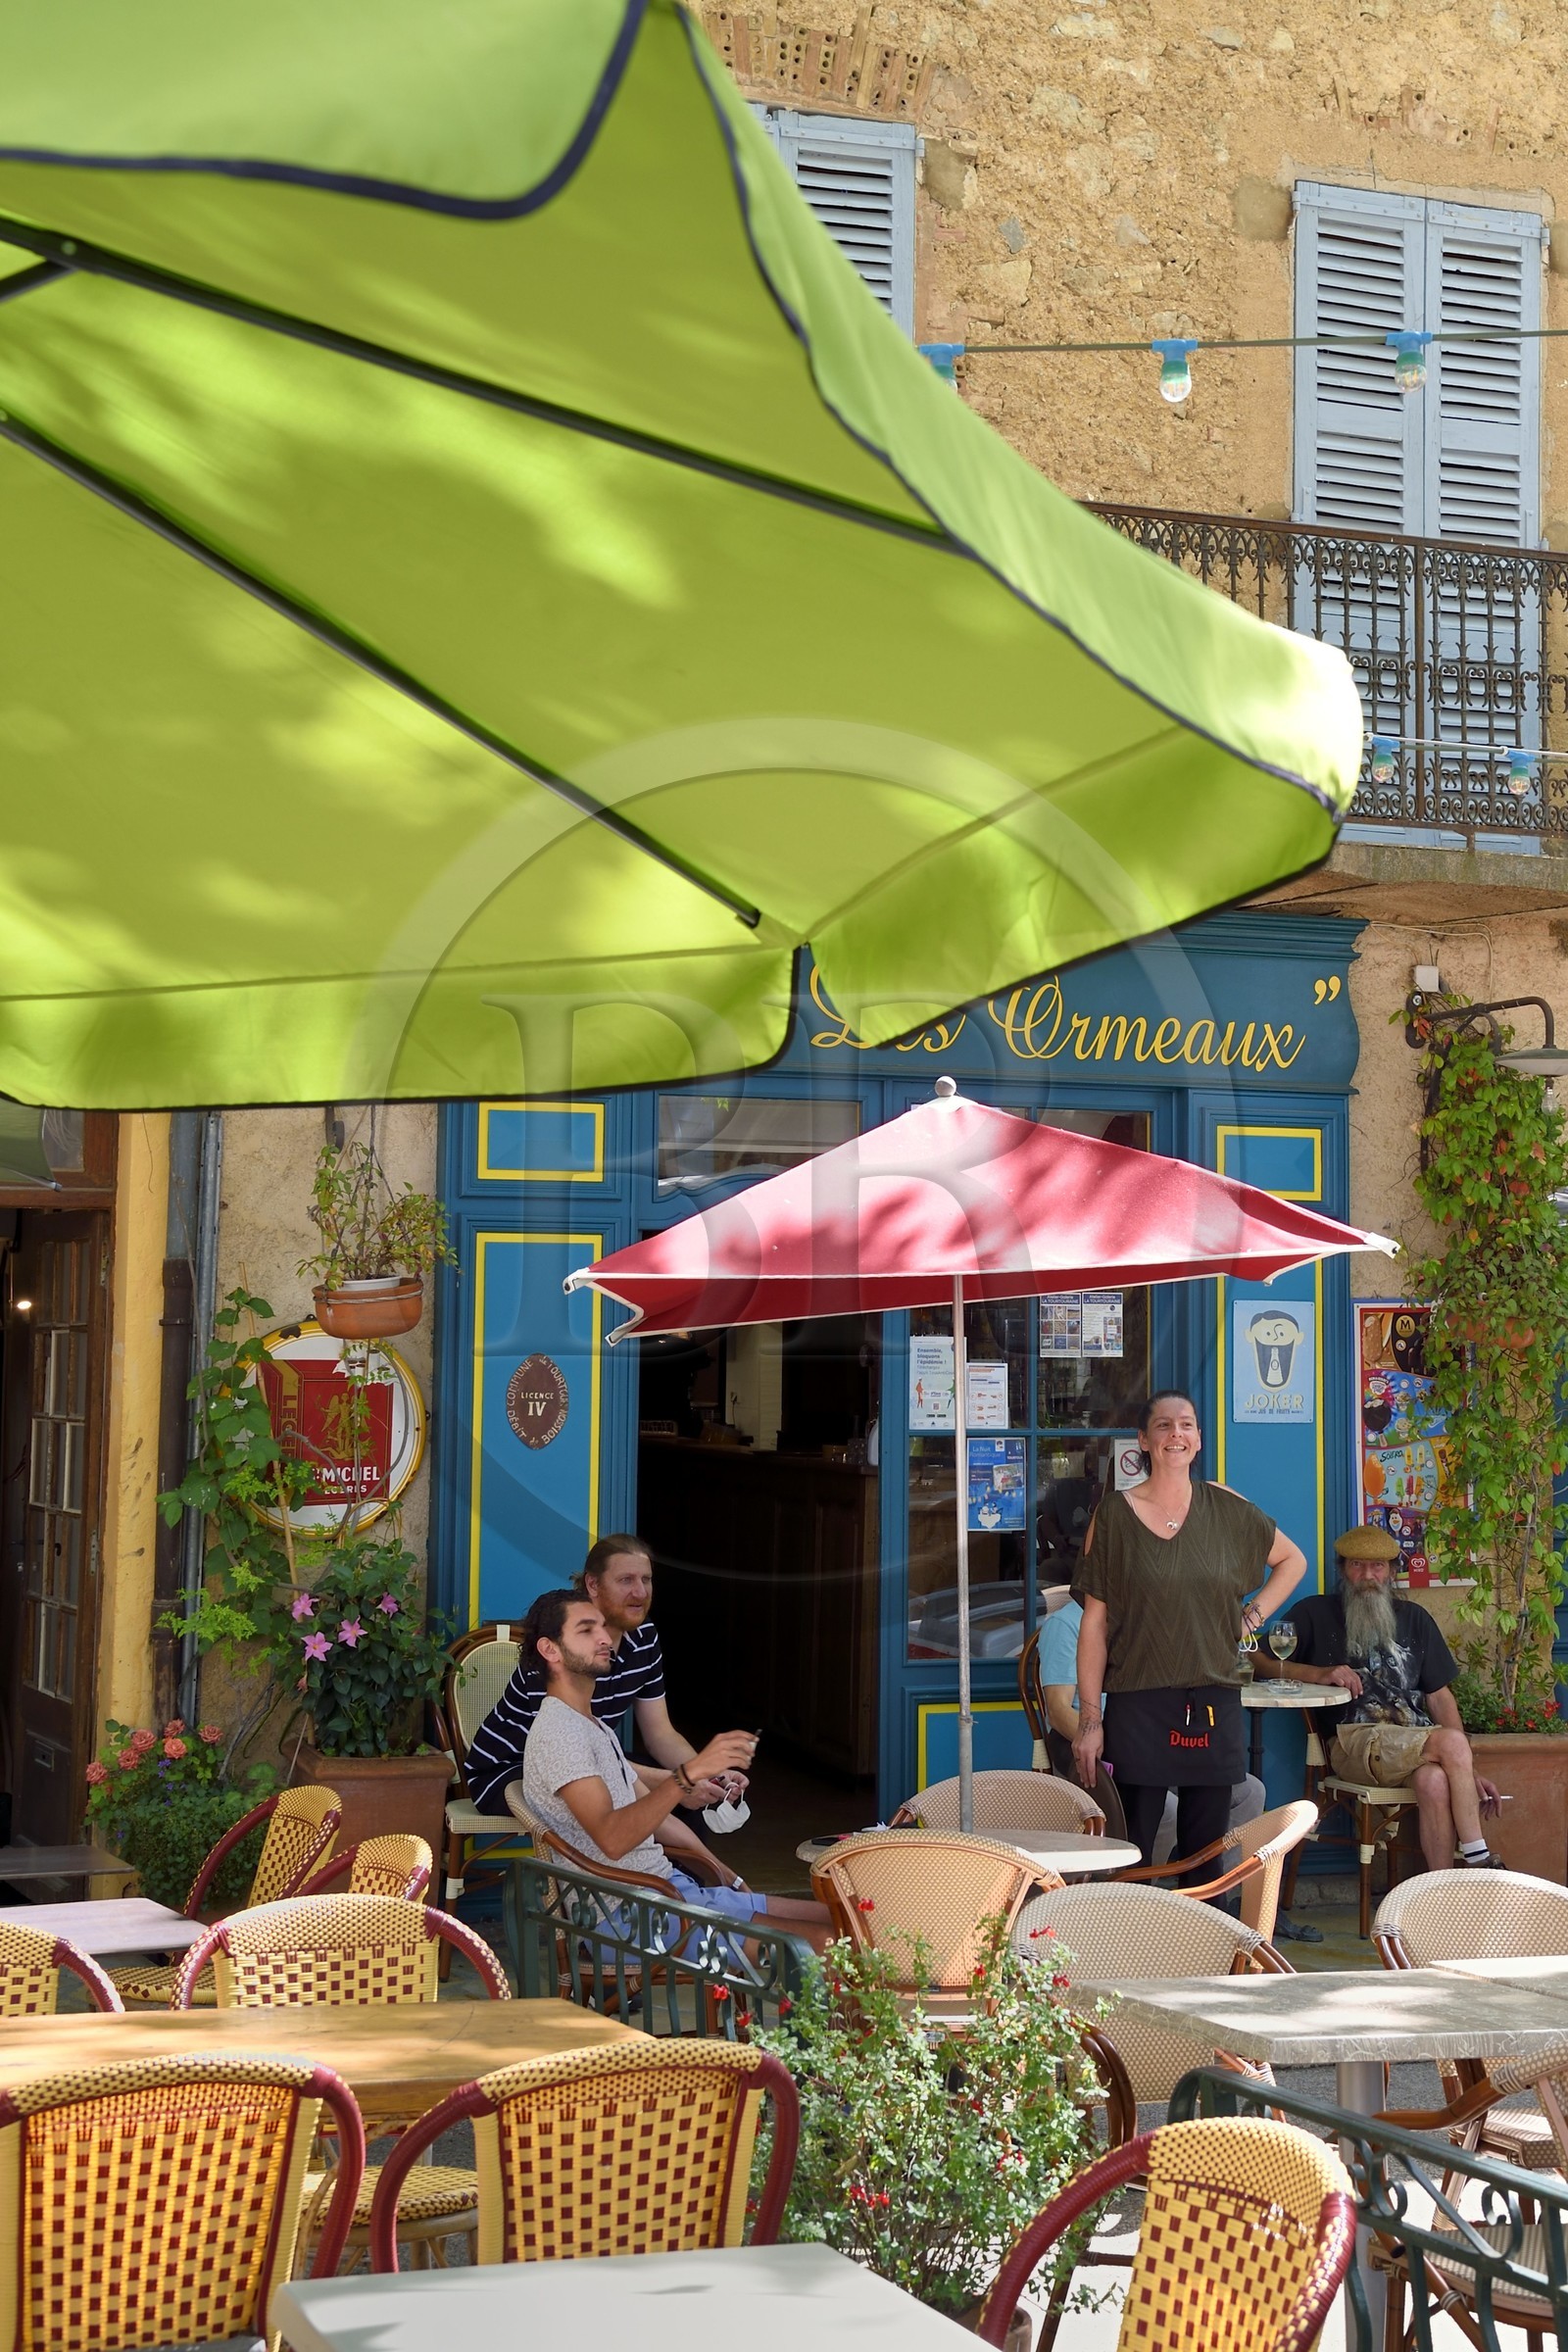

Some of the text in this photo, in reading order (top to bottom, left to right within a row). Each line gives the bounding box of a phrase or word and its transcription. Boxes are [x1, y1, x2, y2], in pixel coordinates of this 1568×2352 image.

[987, 974, 1306, 1072] Ormeaux
[527, 1400, 547, 1417] IV
[1244, 1393, 1304, 1410] JOKER
[1169, 1730, 1210, 1748] Duvel
